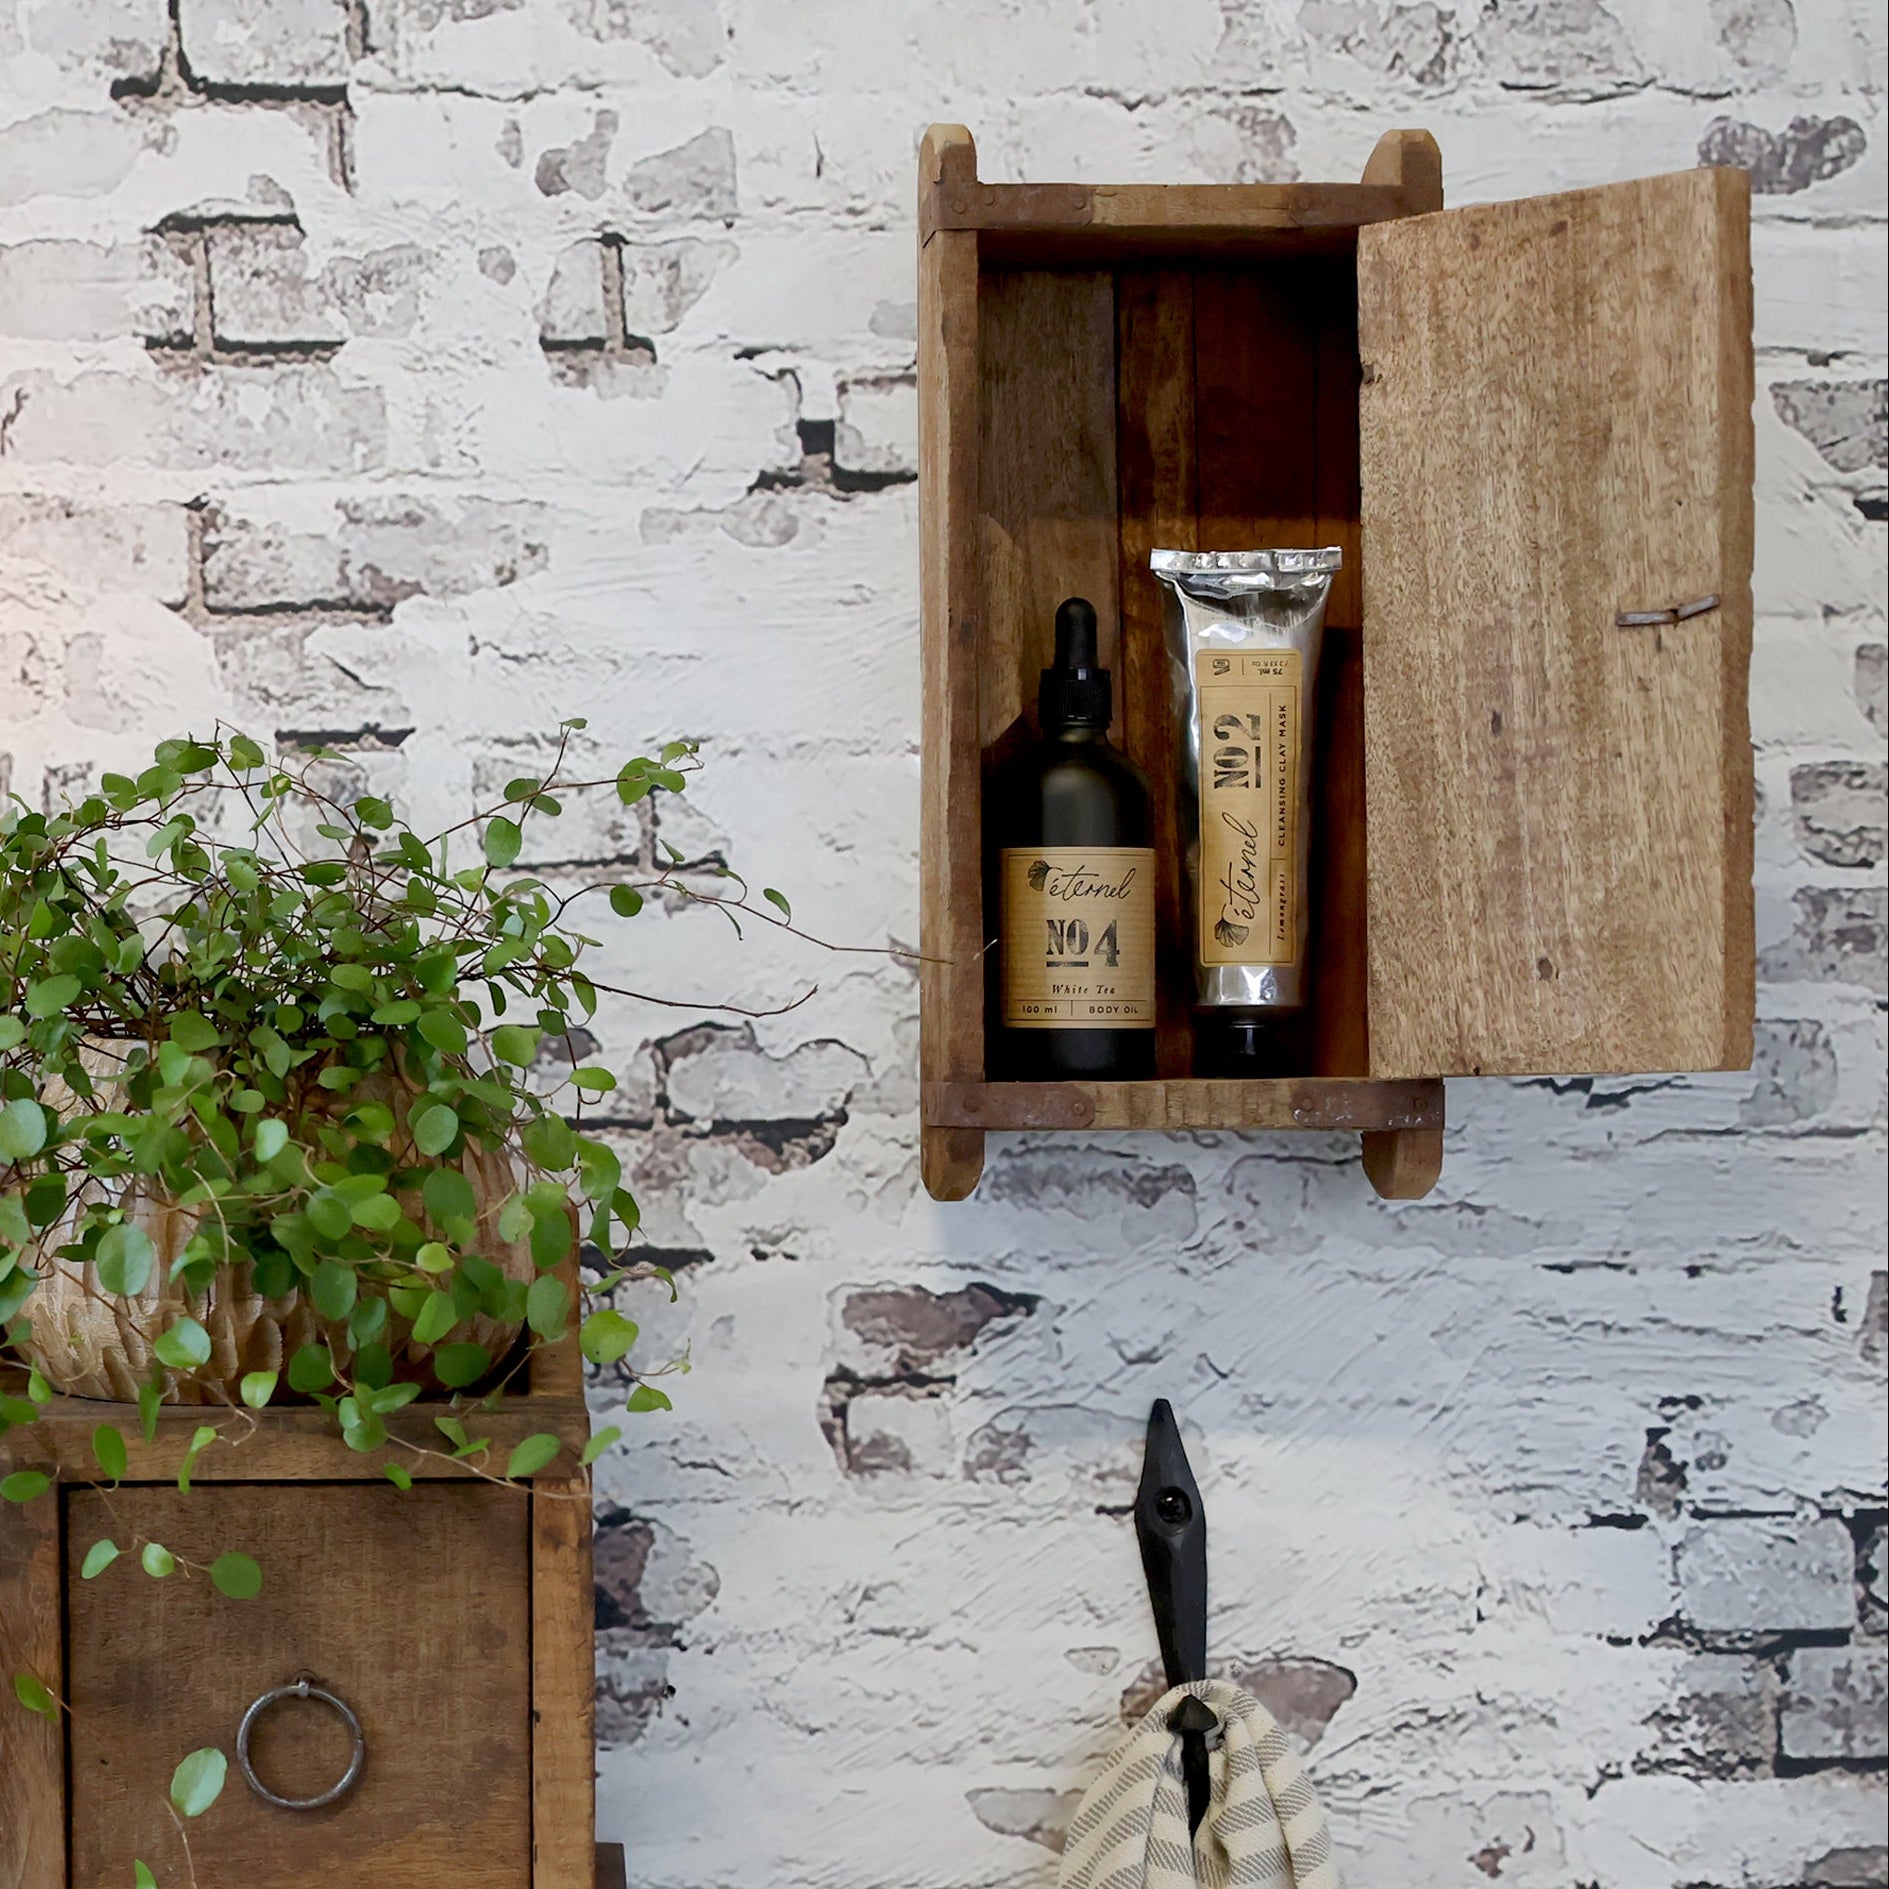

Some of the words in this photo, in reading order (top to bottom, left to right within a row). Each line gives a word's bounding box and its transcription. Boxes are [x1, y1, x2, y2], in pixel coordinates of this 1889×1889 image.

[1278, 705, 1287, 737] MASK
[1278, 743, 1287, 773] CLAY
[1278, 778, 1287, 846] CLEANSING
[1219, 811, 1261, 920] éternel
[1049, 865, 1136, 901] éternel
[1052, 984, 1088, 995] White
[1096, 984, 1116, 995] Tea
[1022, 1005, 1040, 1014] 100
[1044, 1005, 1058, 1014] ml
[1088, 1005, 1119, 1014] BODY
